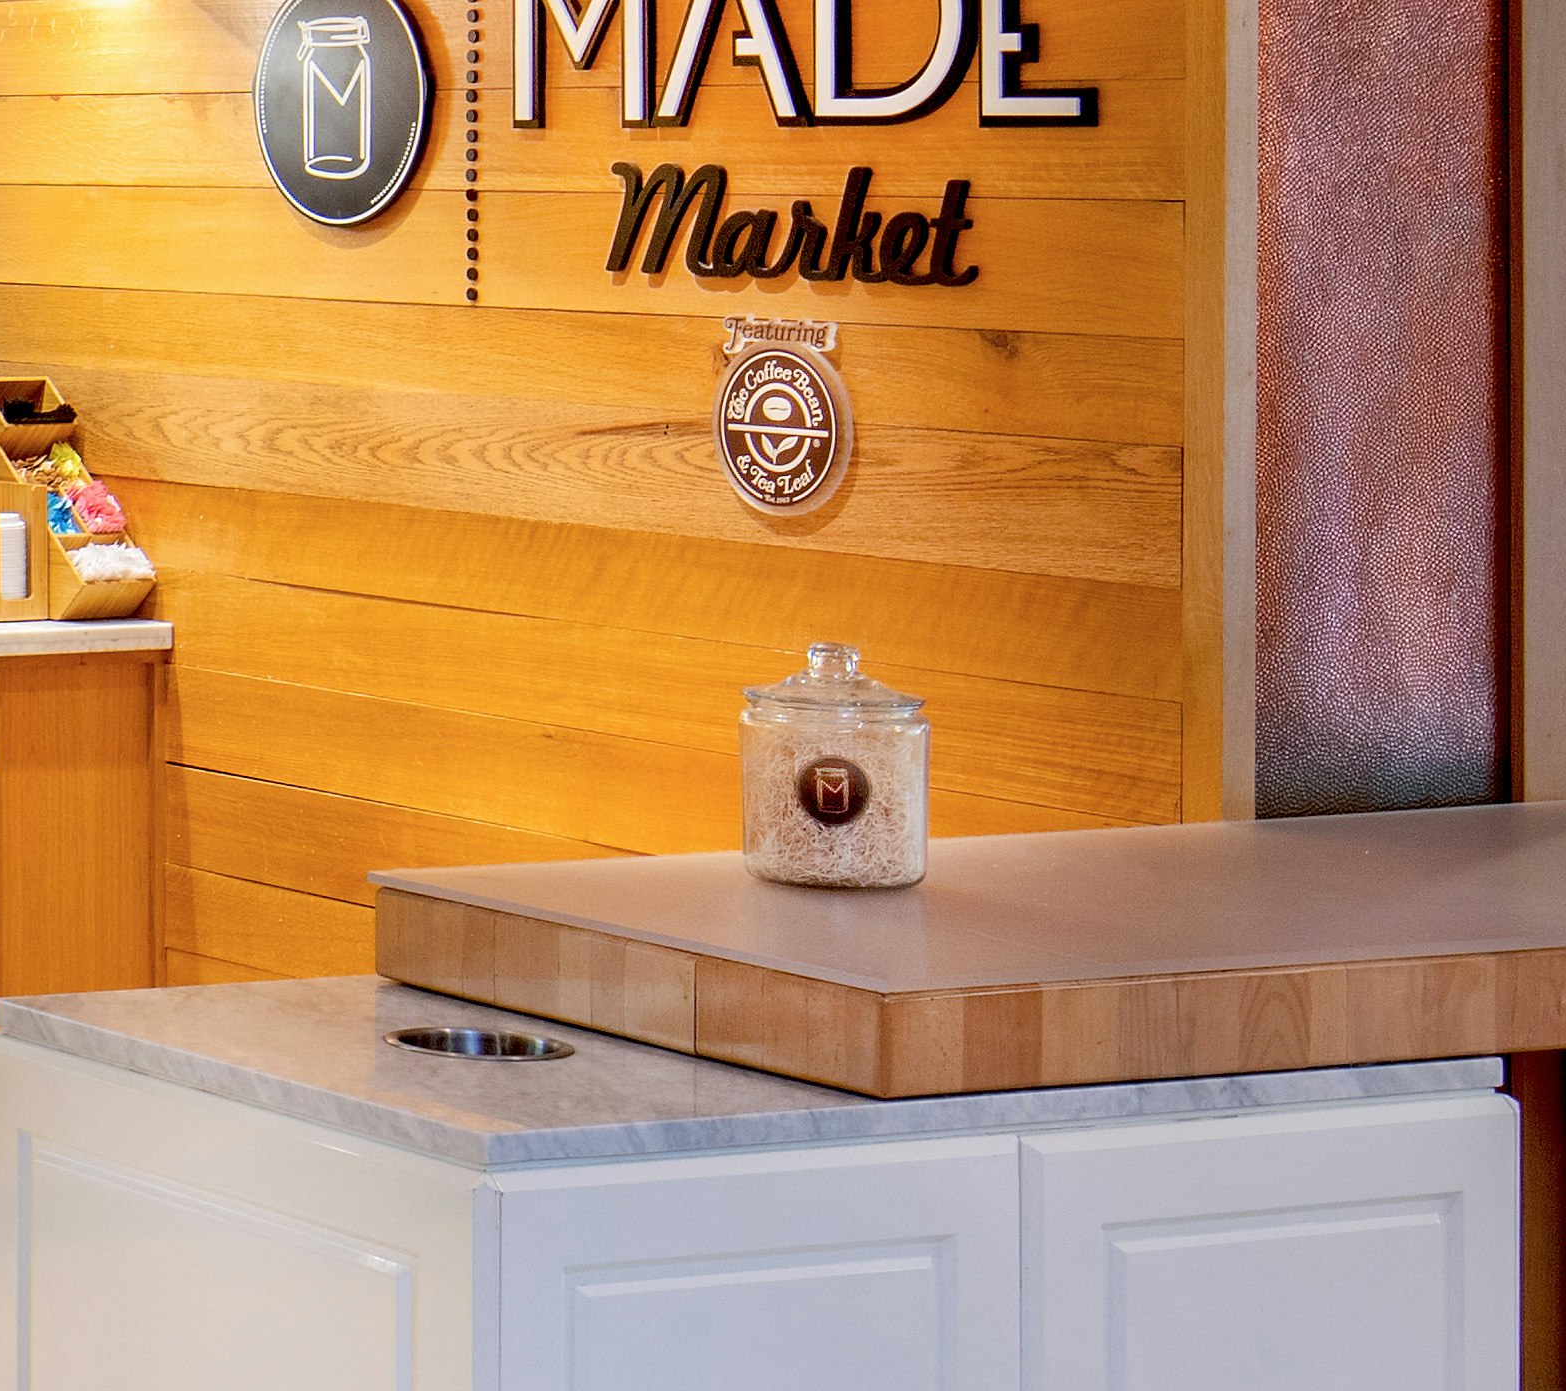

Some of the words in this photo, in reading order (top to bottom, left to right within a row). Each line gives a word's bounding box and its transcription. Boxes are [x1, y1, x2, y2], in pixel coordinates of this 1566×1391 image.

[604, 162, 979, 287] Market
[725, 317, 829, 350] Featuring
[744, 360, 793, 390] Coffee
[793, 369, 824, 427] Bean
[750, 467, 776, 495] Tea
[777, 460, 816, 495] Leaf
